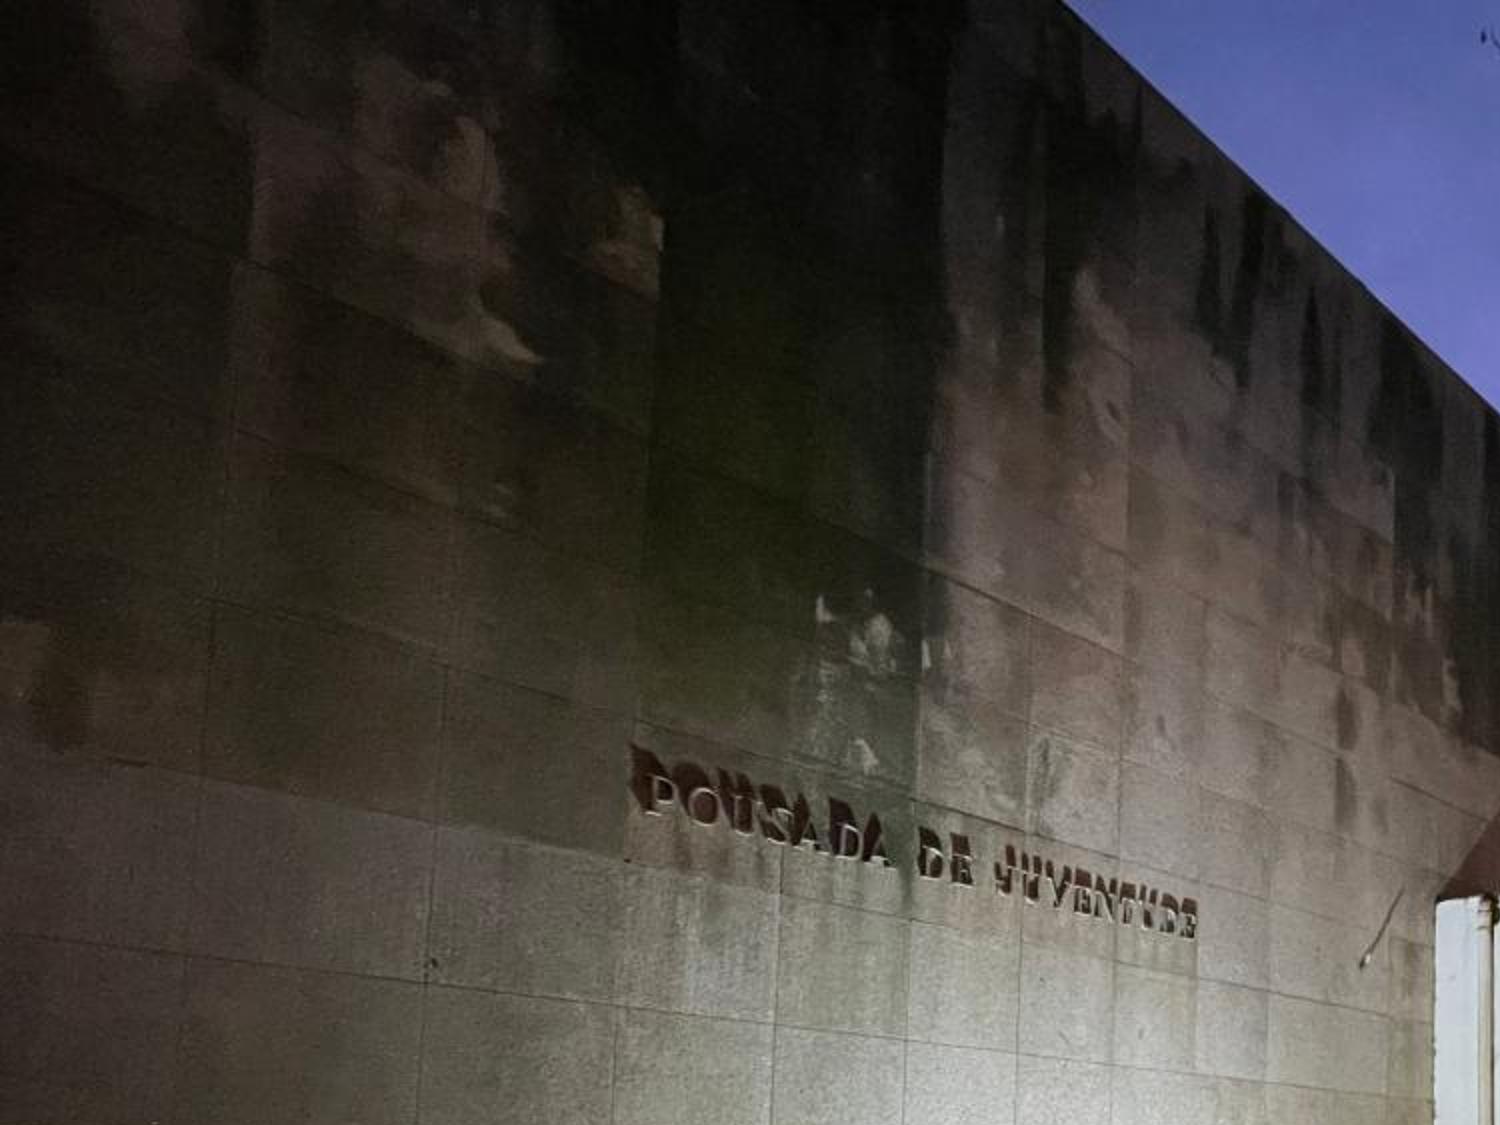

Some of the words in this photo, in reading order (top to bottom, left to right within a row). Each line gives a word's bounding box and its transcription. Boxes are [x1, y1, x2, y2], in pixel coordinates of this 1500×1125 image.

[639, 766, 898, 871] POUSADA
[917, 838, 975, 889] DE
[993, 856, 1198, 940] JUVENTUDE
